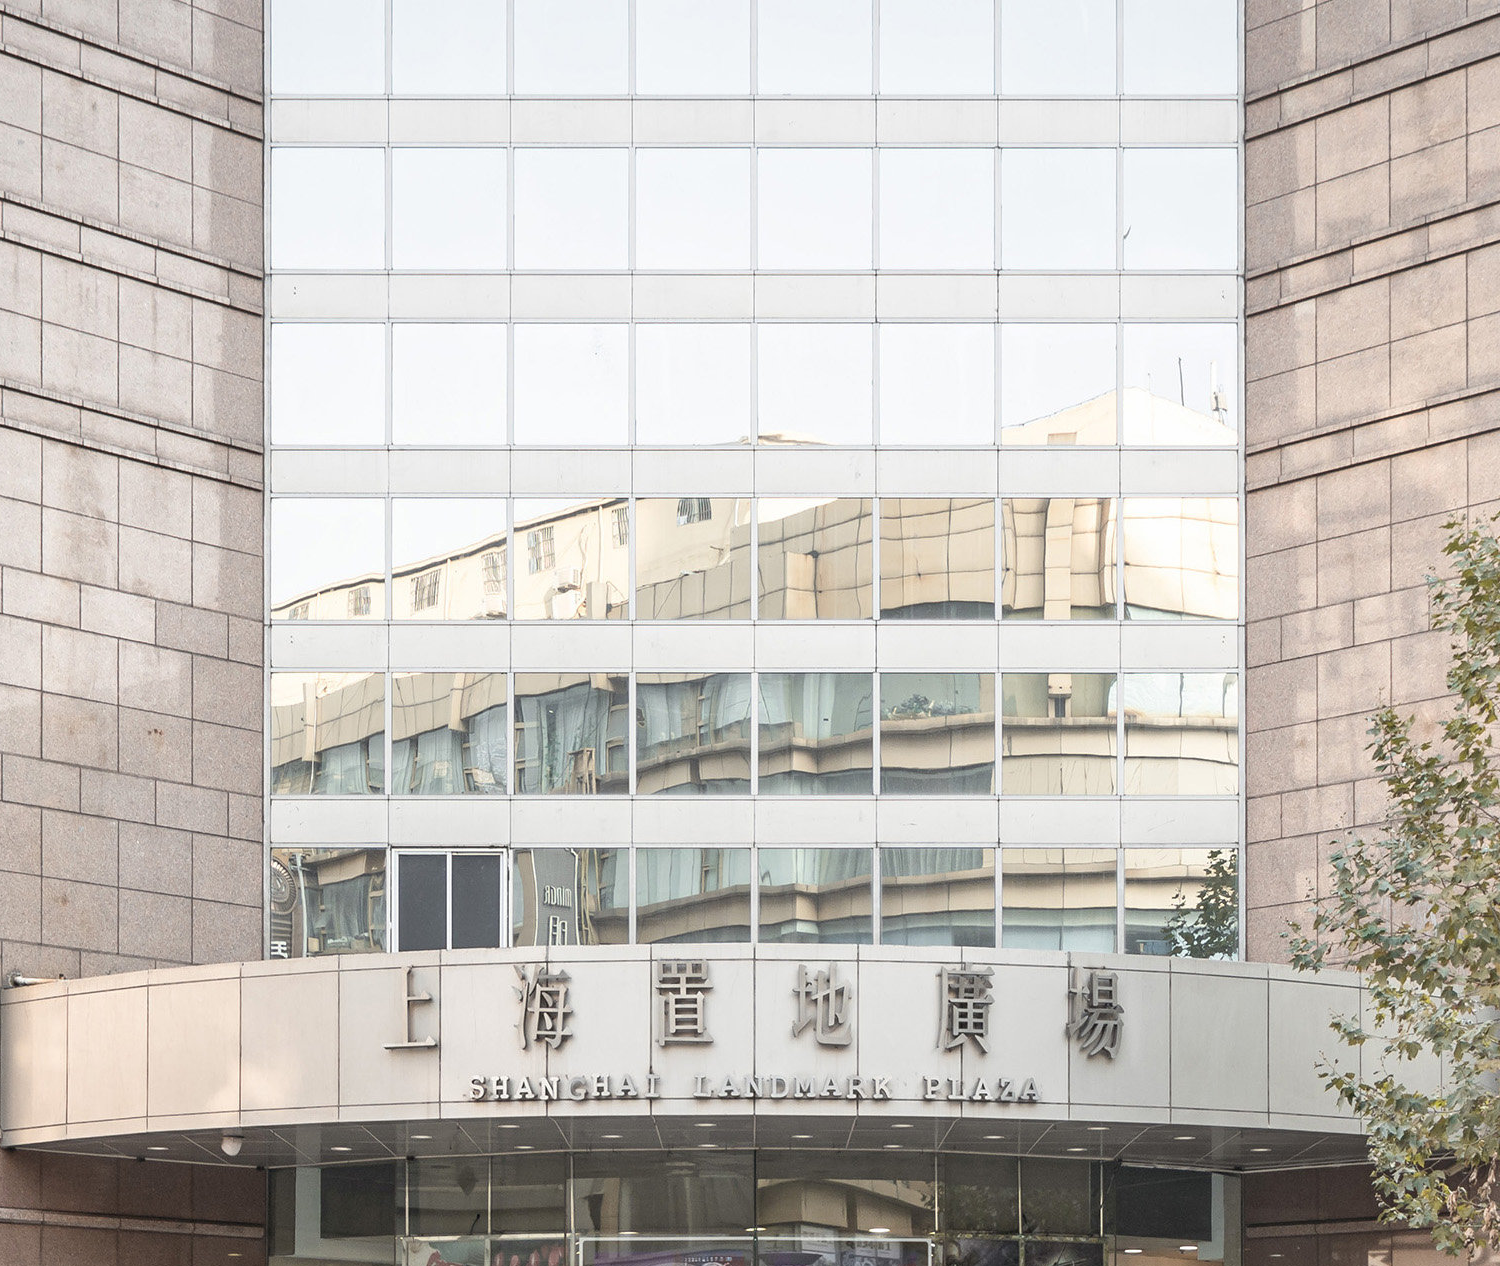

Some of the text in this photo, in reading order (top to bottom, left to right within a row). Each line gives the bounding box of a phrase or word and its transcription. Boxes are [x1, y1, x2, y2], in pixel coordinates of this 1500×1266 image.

[382, 957, 1127, 1060] 上海置地廣場
[468, 1073, 1043, 1104] SHANGHAI LANDMARK PLAZA
